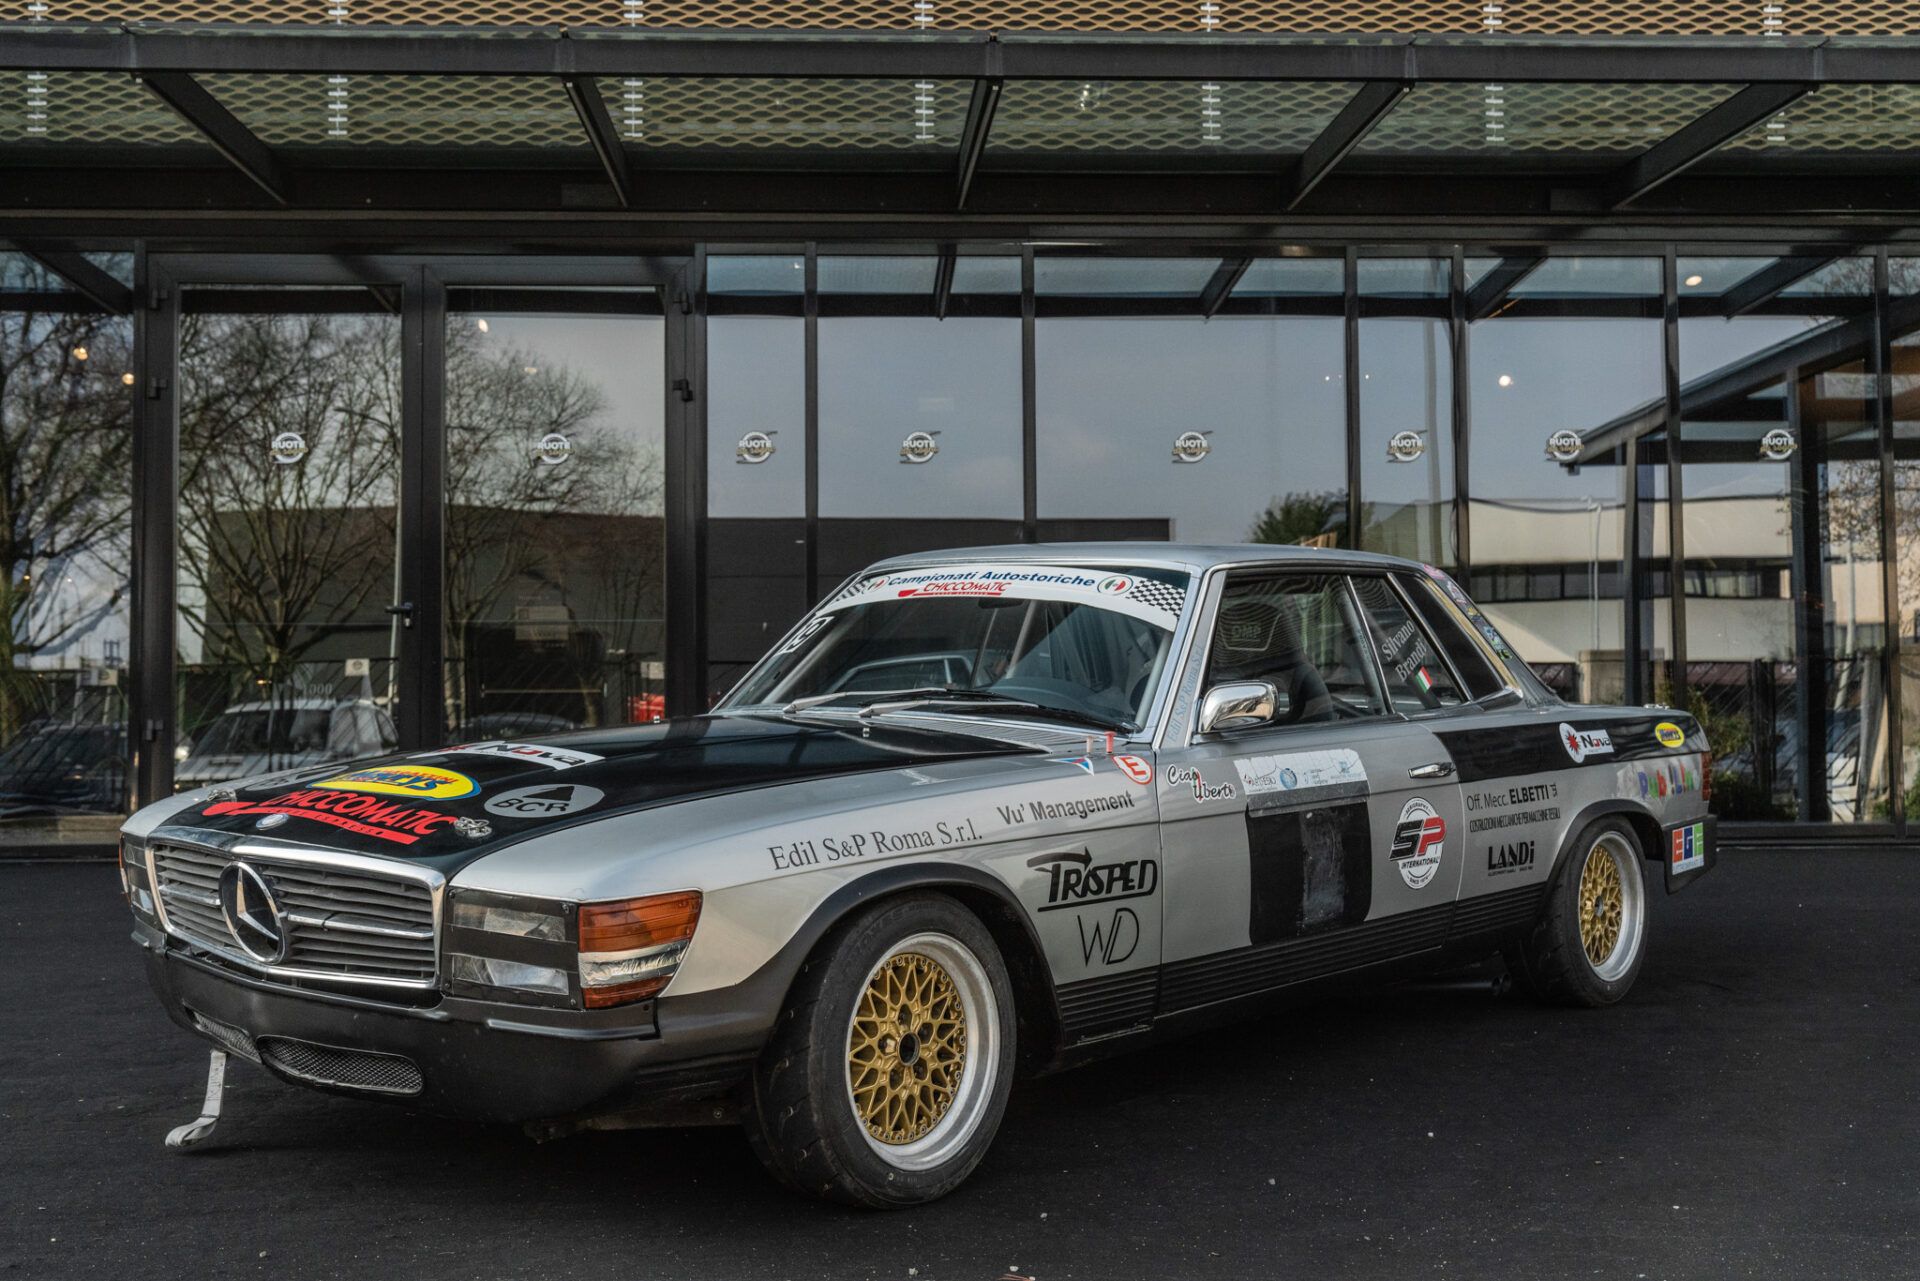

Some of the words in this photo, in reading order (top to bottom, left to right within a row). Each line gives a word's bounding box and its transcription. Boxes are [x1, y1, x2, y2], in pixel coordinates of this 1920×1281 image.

[272, 440, 306, 449] RUOTE
[538, 441, 571, 450] RUOTE
[739, 440, 772, 448] RUOTE
[903, 440, 935, 448] RUOTE
[1175, 440, 1208, 448] RUOTE
[1391, 439, 1423, 448] RUOTE
[1550, 438, 1582, 447] RUOTE
[1762, 437, 1794, 446] RUOTE
[888, 571, 978, 586] Campionati
[981, 571, 1096, 587] Autostoriche
[923, 582, 1013, 593] CHICCOMATIC
[1382, 620, 1415, 662] Silvano
[1395, 638, 1427, 682] Brandi
[1580, 734, 1611, 748] Nova
[1467, 794, 1483, 811] Off.
[1509, 784, 1549, 804] ELBETTI
[492, 798, 570, 813] BCR
[997, 803, 1026, 826] Vu'
[1028, 789, 1136, 822] Management
[259, 790, 458, 836] CHICCOMATIC
[768, 841, 819, 871] Edil
[827, 834, 867, 862] S&P
[870, 828, 935, 854] Roma
[938, 818, 983, 844] S.r.l.
[1389, 815, 1447, 861] SP
[1077, 907, 1140, 967] WD
